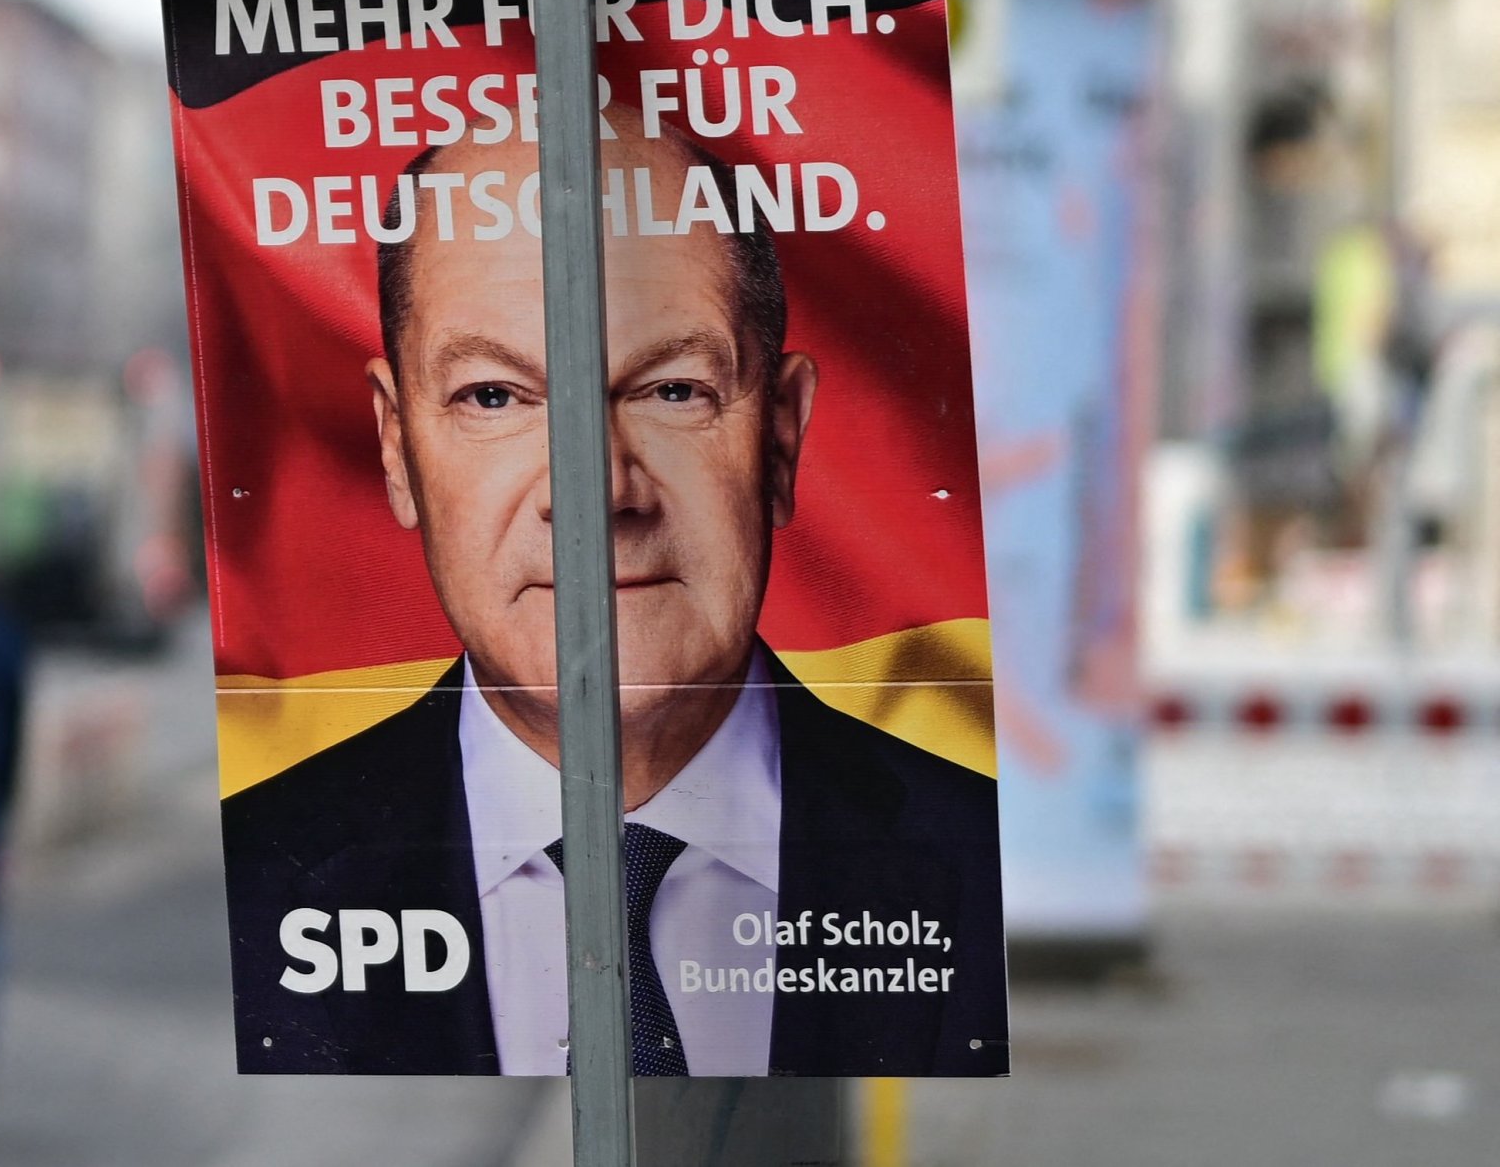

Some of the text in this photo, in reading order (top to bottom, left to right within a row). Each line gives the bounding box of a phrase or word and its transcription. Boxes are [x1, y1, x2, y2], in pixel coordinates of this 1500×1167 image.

[639, 48, 804, 138] FÜR
[278, 907, 471, 994] SPD
[732, 910, 953, 953] Olaf Scholz,
[679, 957, 955, 994] Bundeskanzler
